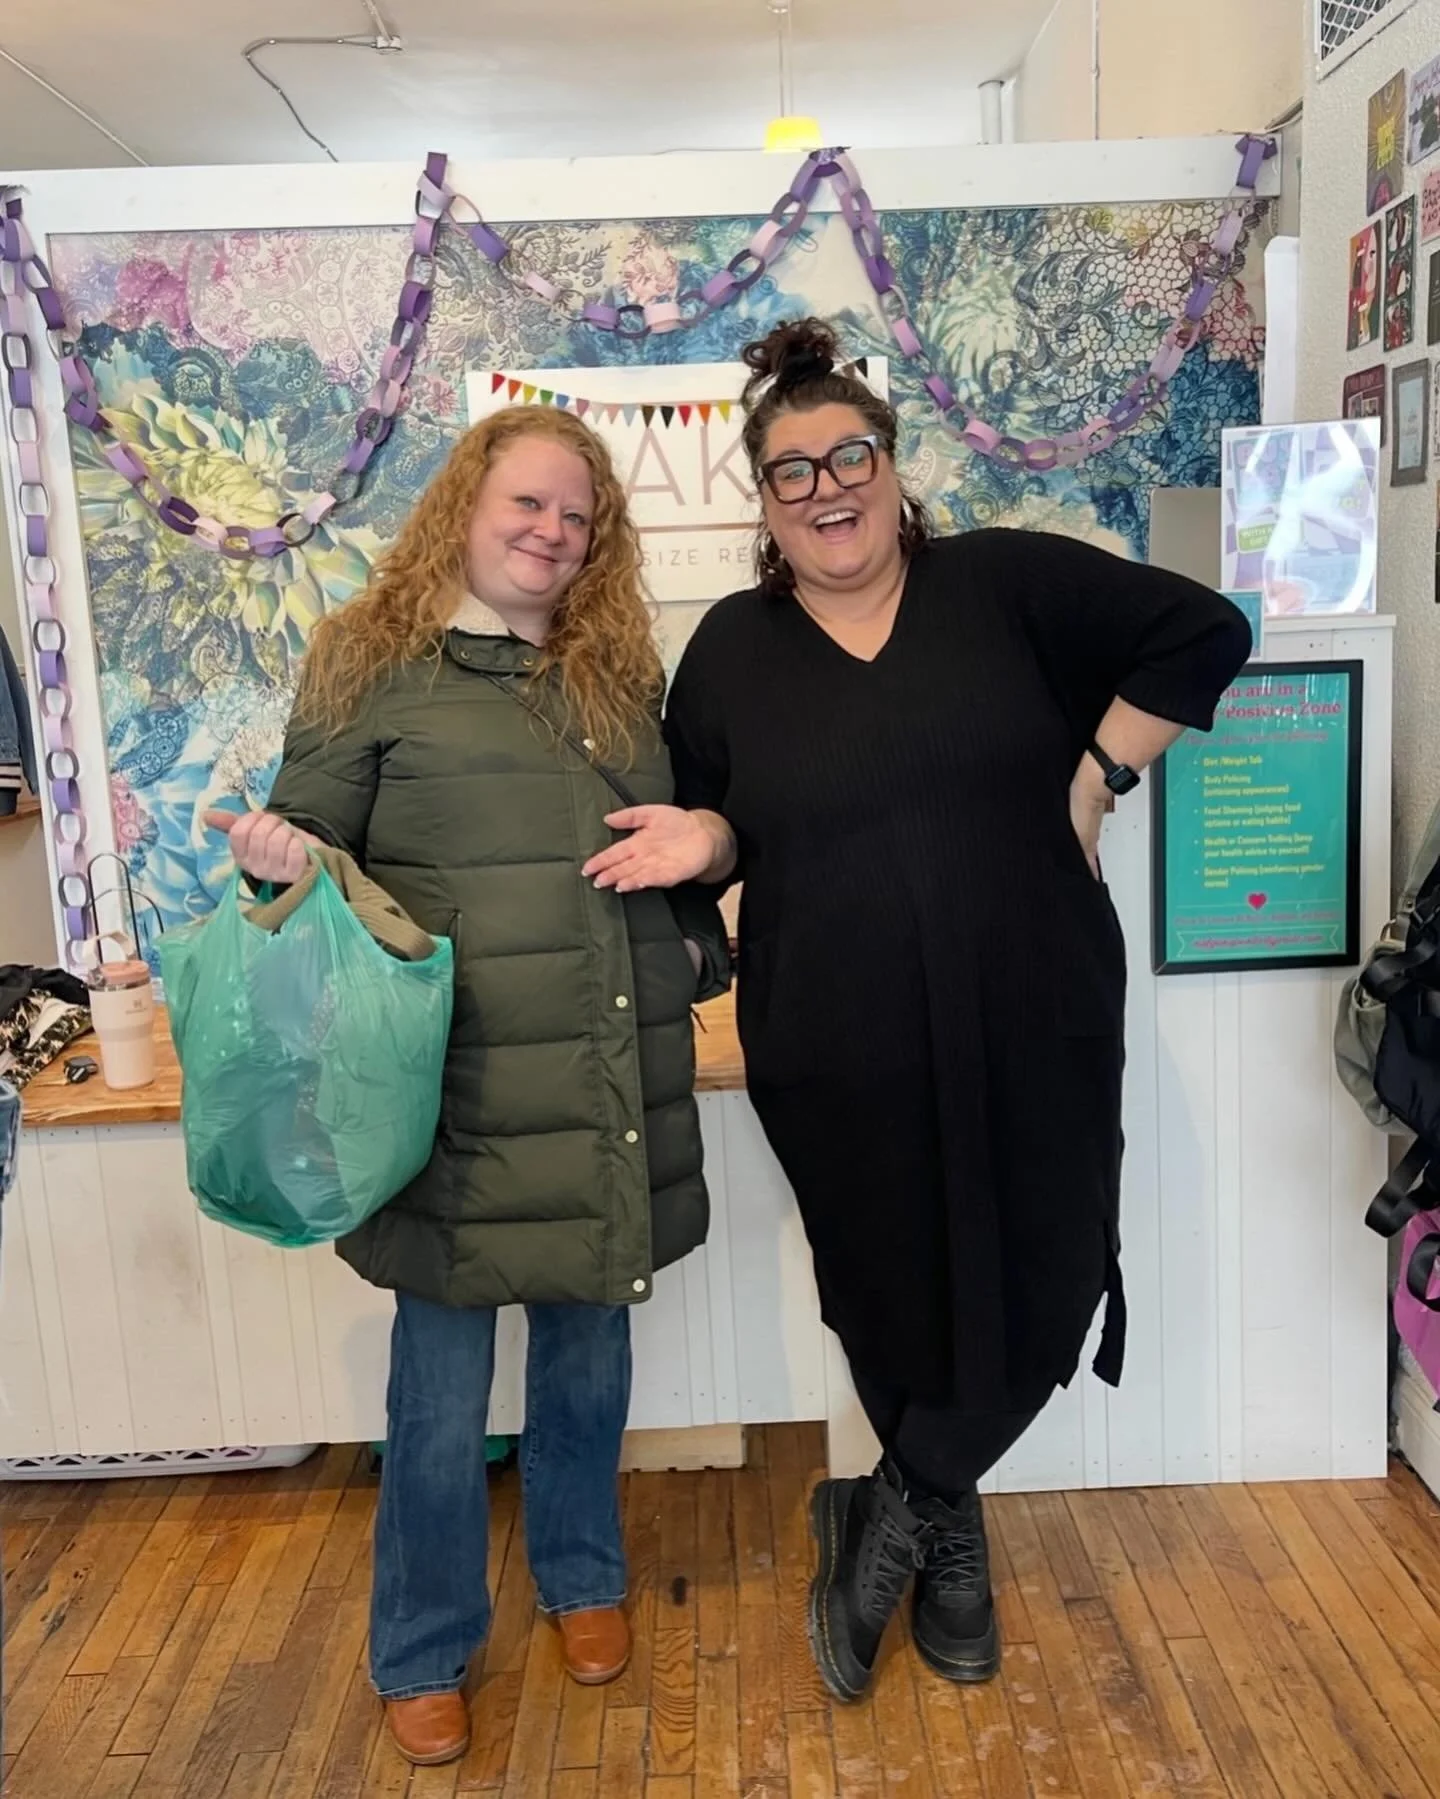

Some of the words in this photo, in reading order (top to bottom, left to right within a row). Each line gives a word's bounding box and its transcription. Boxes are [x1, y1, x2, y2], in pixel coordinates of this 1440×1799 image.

[641, 550, 700, 567] SIZE
[1277, 684, 1293, 695] in
[1226, 704, 1295, 719] Positive
[1299, 702, 1342, 715] Zone
[1204, 774, 1221, 784] Body
[1222, 773, 1252, 784] Policing
[1204, 806, 1221, 815] Food
[1222, 805, 1253, 816] Shaming
[1285, 802, 1301, 812] food
[1241, 816, 1265, 827] eating
[1203, 836, 1227, 846] Health
[1204, 850, 1220, 860] your
[1220, 848, 1243, 857] health
